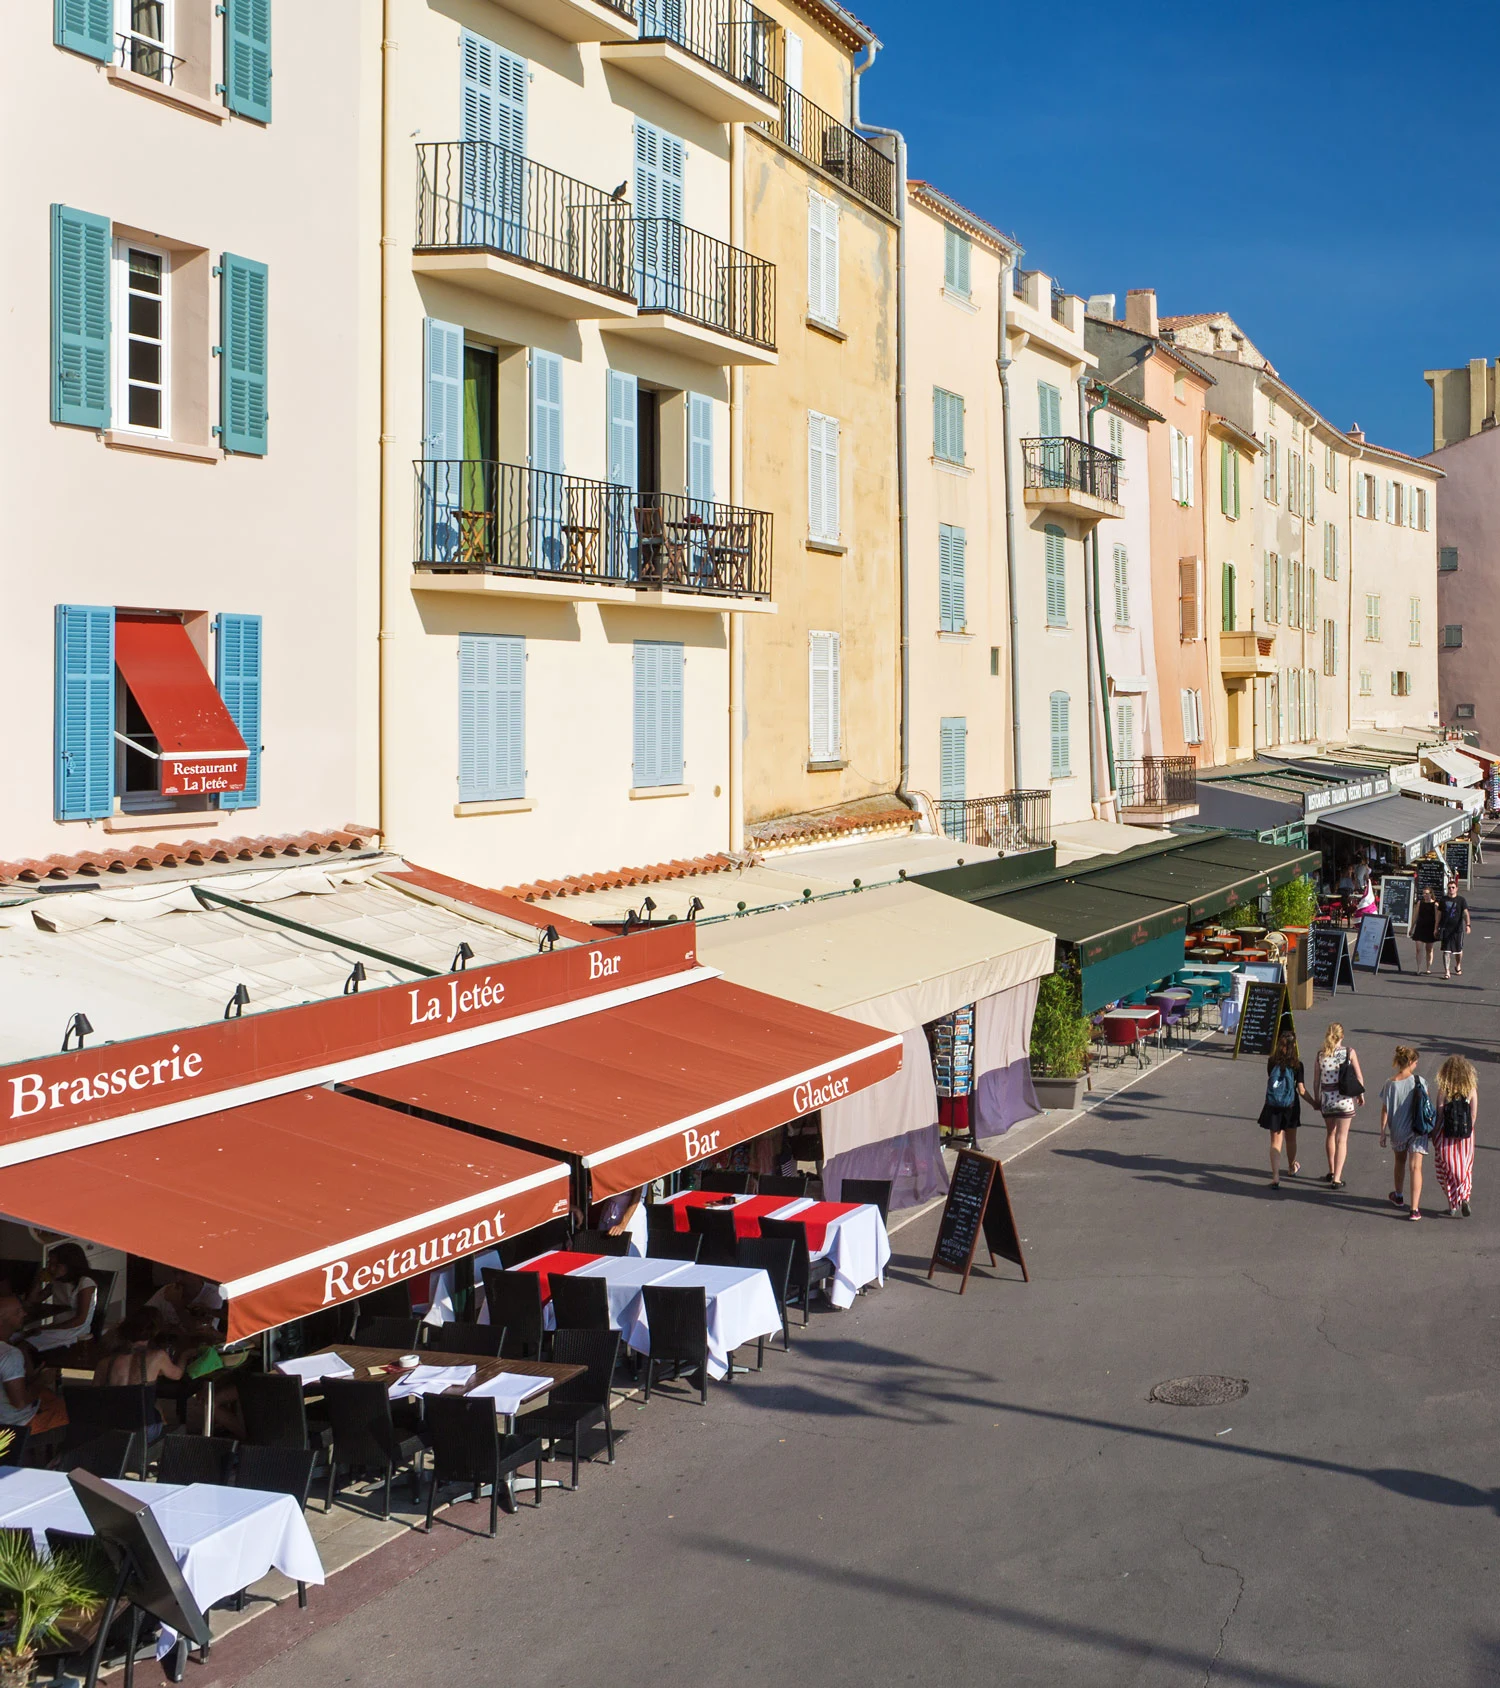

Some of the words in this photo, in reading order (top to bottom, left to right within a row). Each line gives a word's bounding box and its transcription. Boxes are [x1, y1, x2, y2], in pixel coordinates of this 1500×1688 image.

[173, 762, 238, 775] Restaurant
[183, 777, 199, 791] La
[200, 776, 228, 793] Jetée
[407, 988, 442, 1025] La
[446, 976, 506, 1024] Jetée
[588, 950, 622, 979] Bar
[8, 1044, 203, 1119] Brasserie
[682, 1127, 721, 1162] Bar
[793, 1074, 851, 1114] Glacier
[320, 1209, 507, 1305] Restaurant
